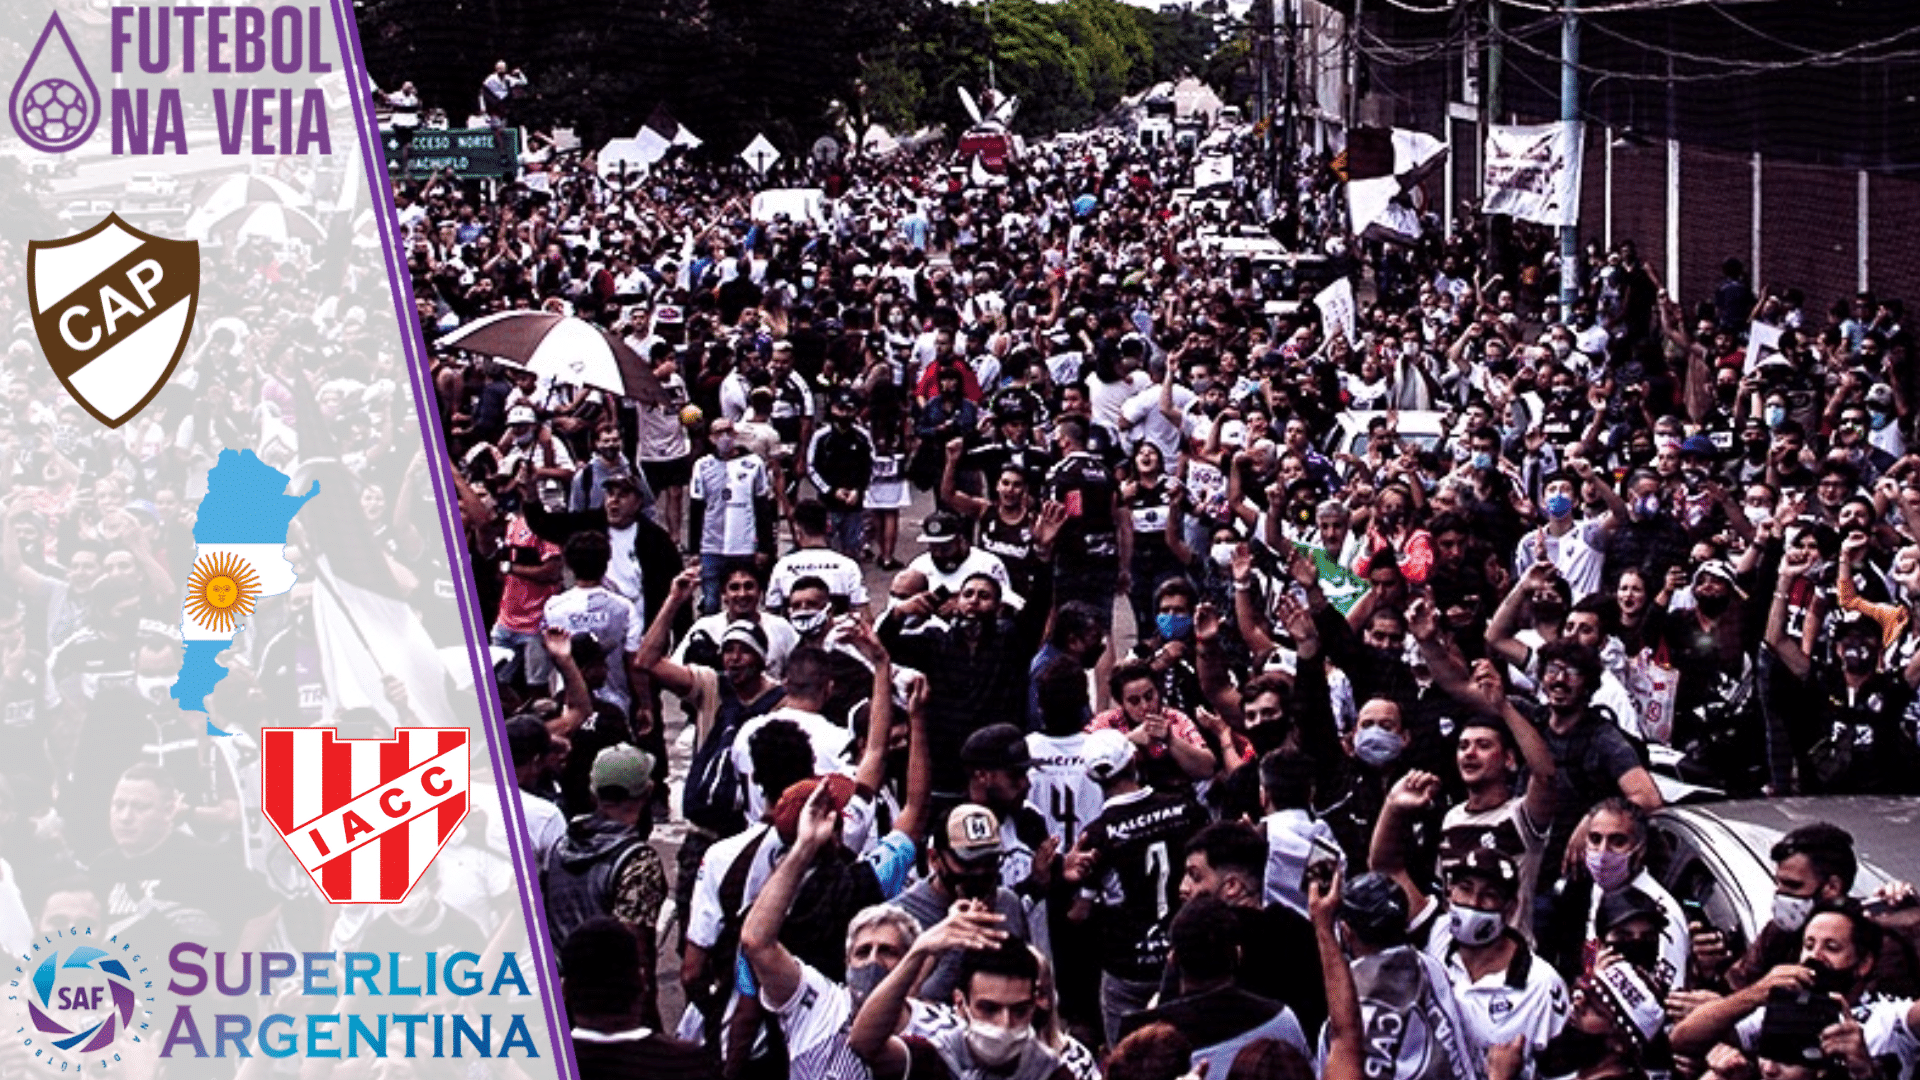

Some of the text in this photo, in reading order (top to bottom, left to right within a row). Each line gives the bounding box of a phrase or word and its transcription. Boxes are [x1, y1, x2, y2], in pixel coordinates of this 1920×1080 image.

[412, 135, 494, 149] CCESO NORTE
[1050, 782, 1081, 852] 4
